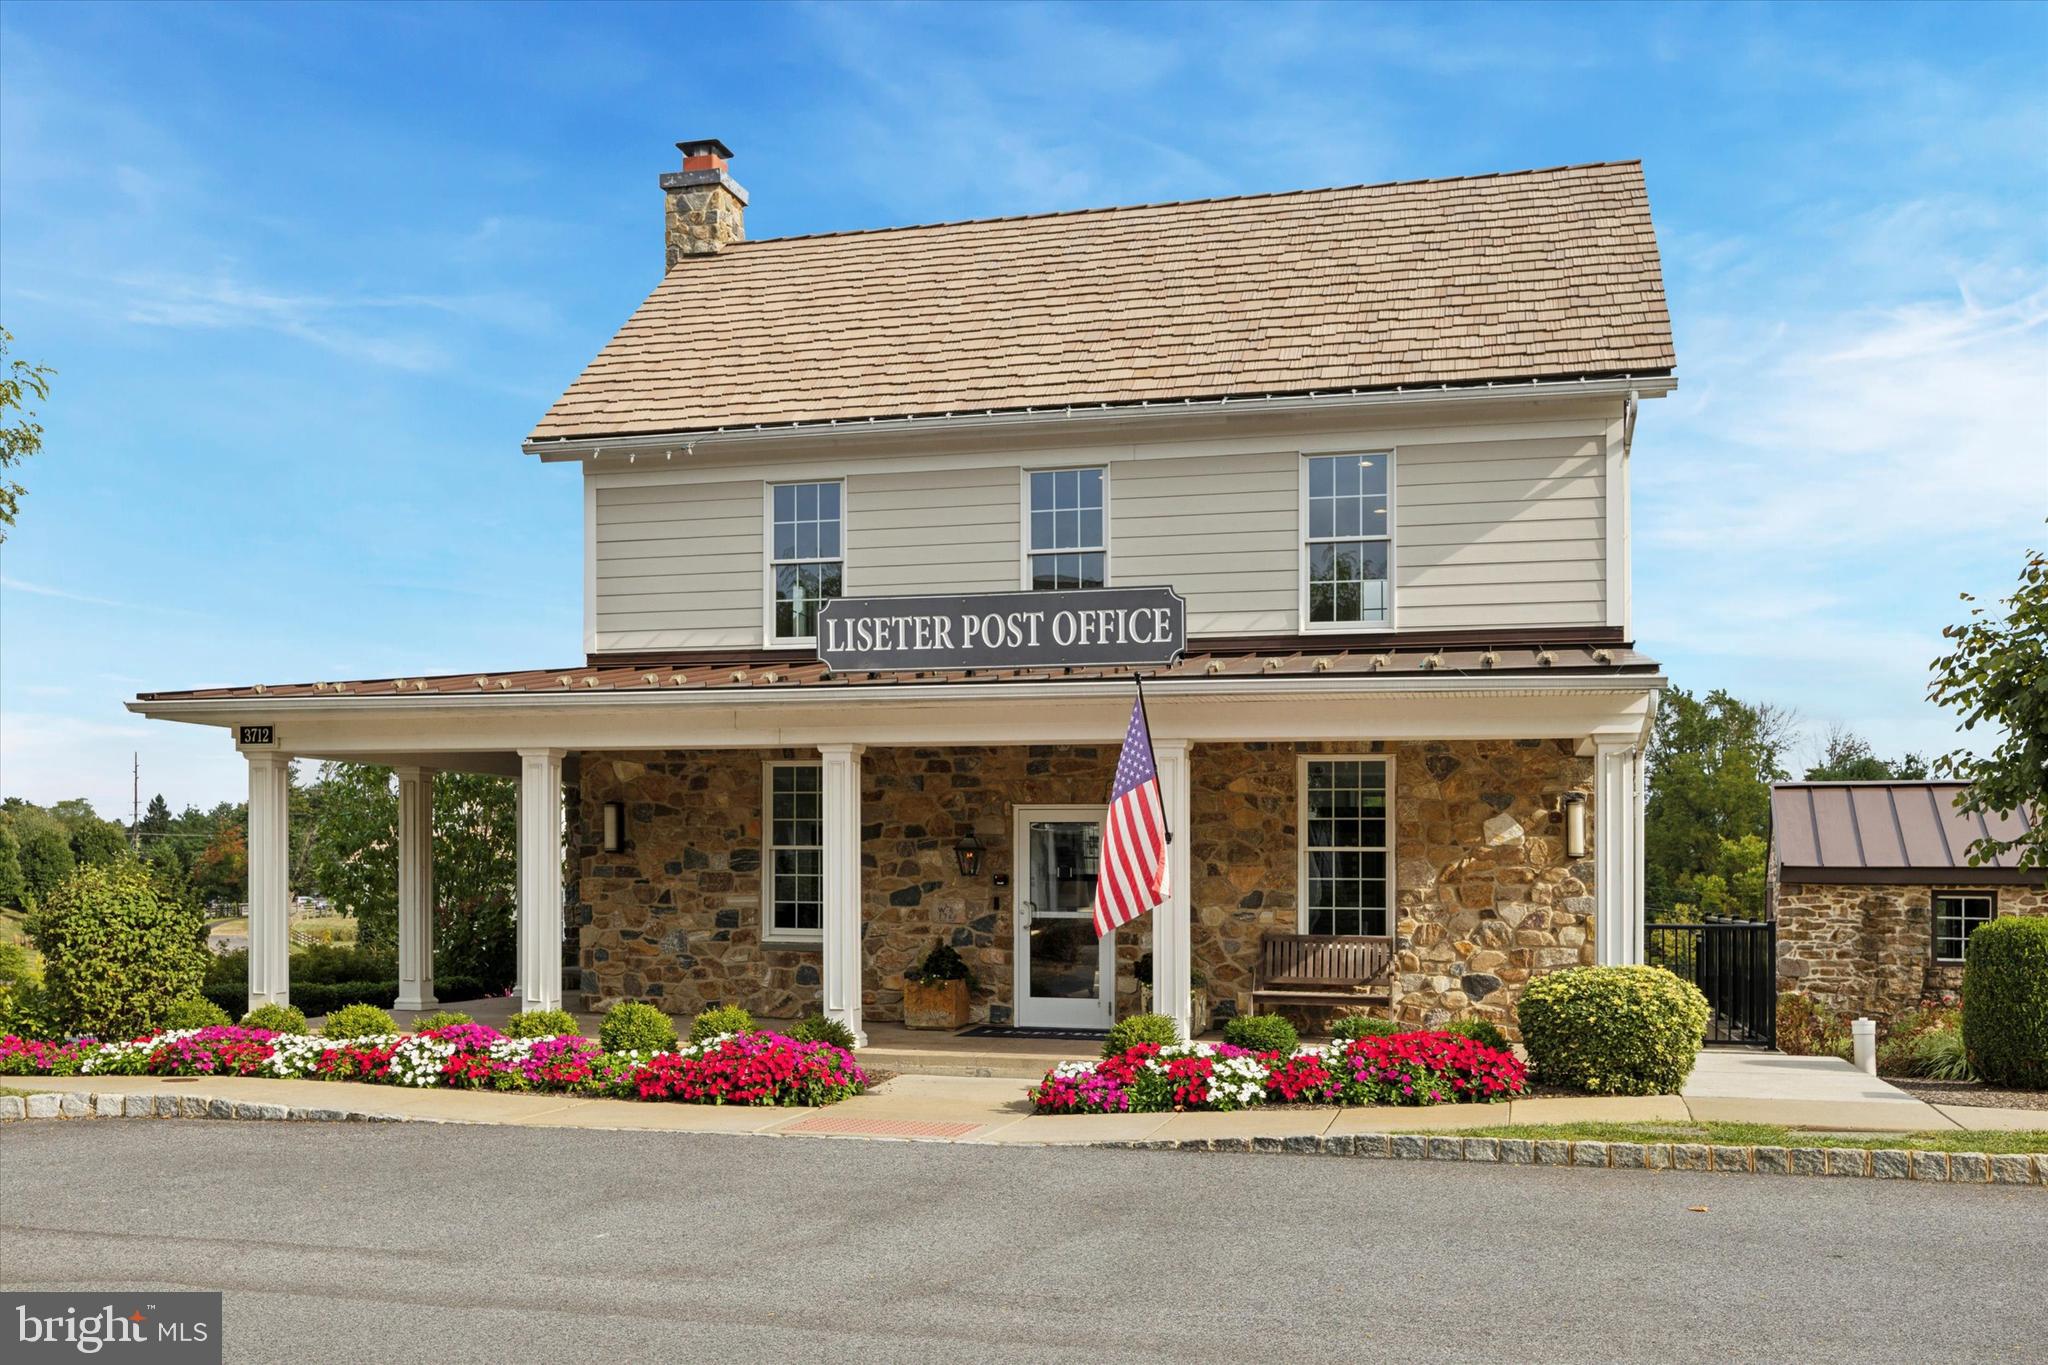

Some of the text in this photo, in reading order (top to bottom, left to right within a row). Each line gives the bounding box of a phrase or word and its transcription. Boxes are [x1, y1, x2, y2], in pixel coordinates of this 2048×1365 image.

[826, 607, 1173, 652] LISETER POST OFFICE
[244, 728, 269, 743] 3712
